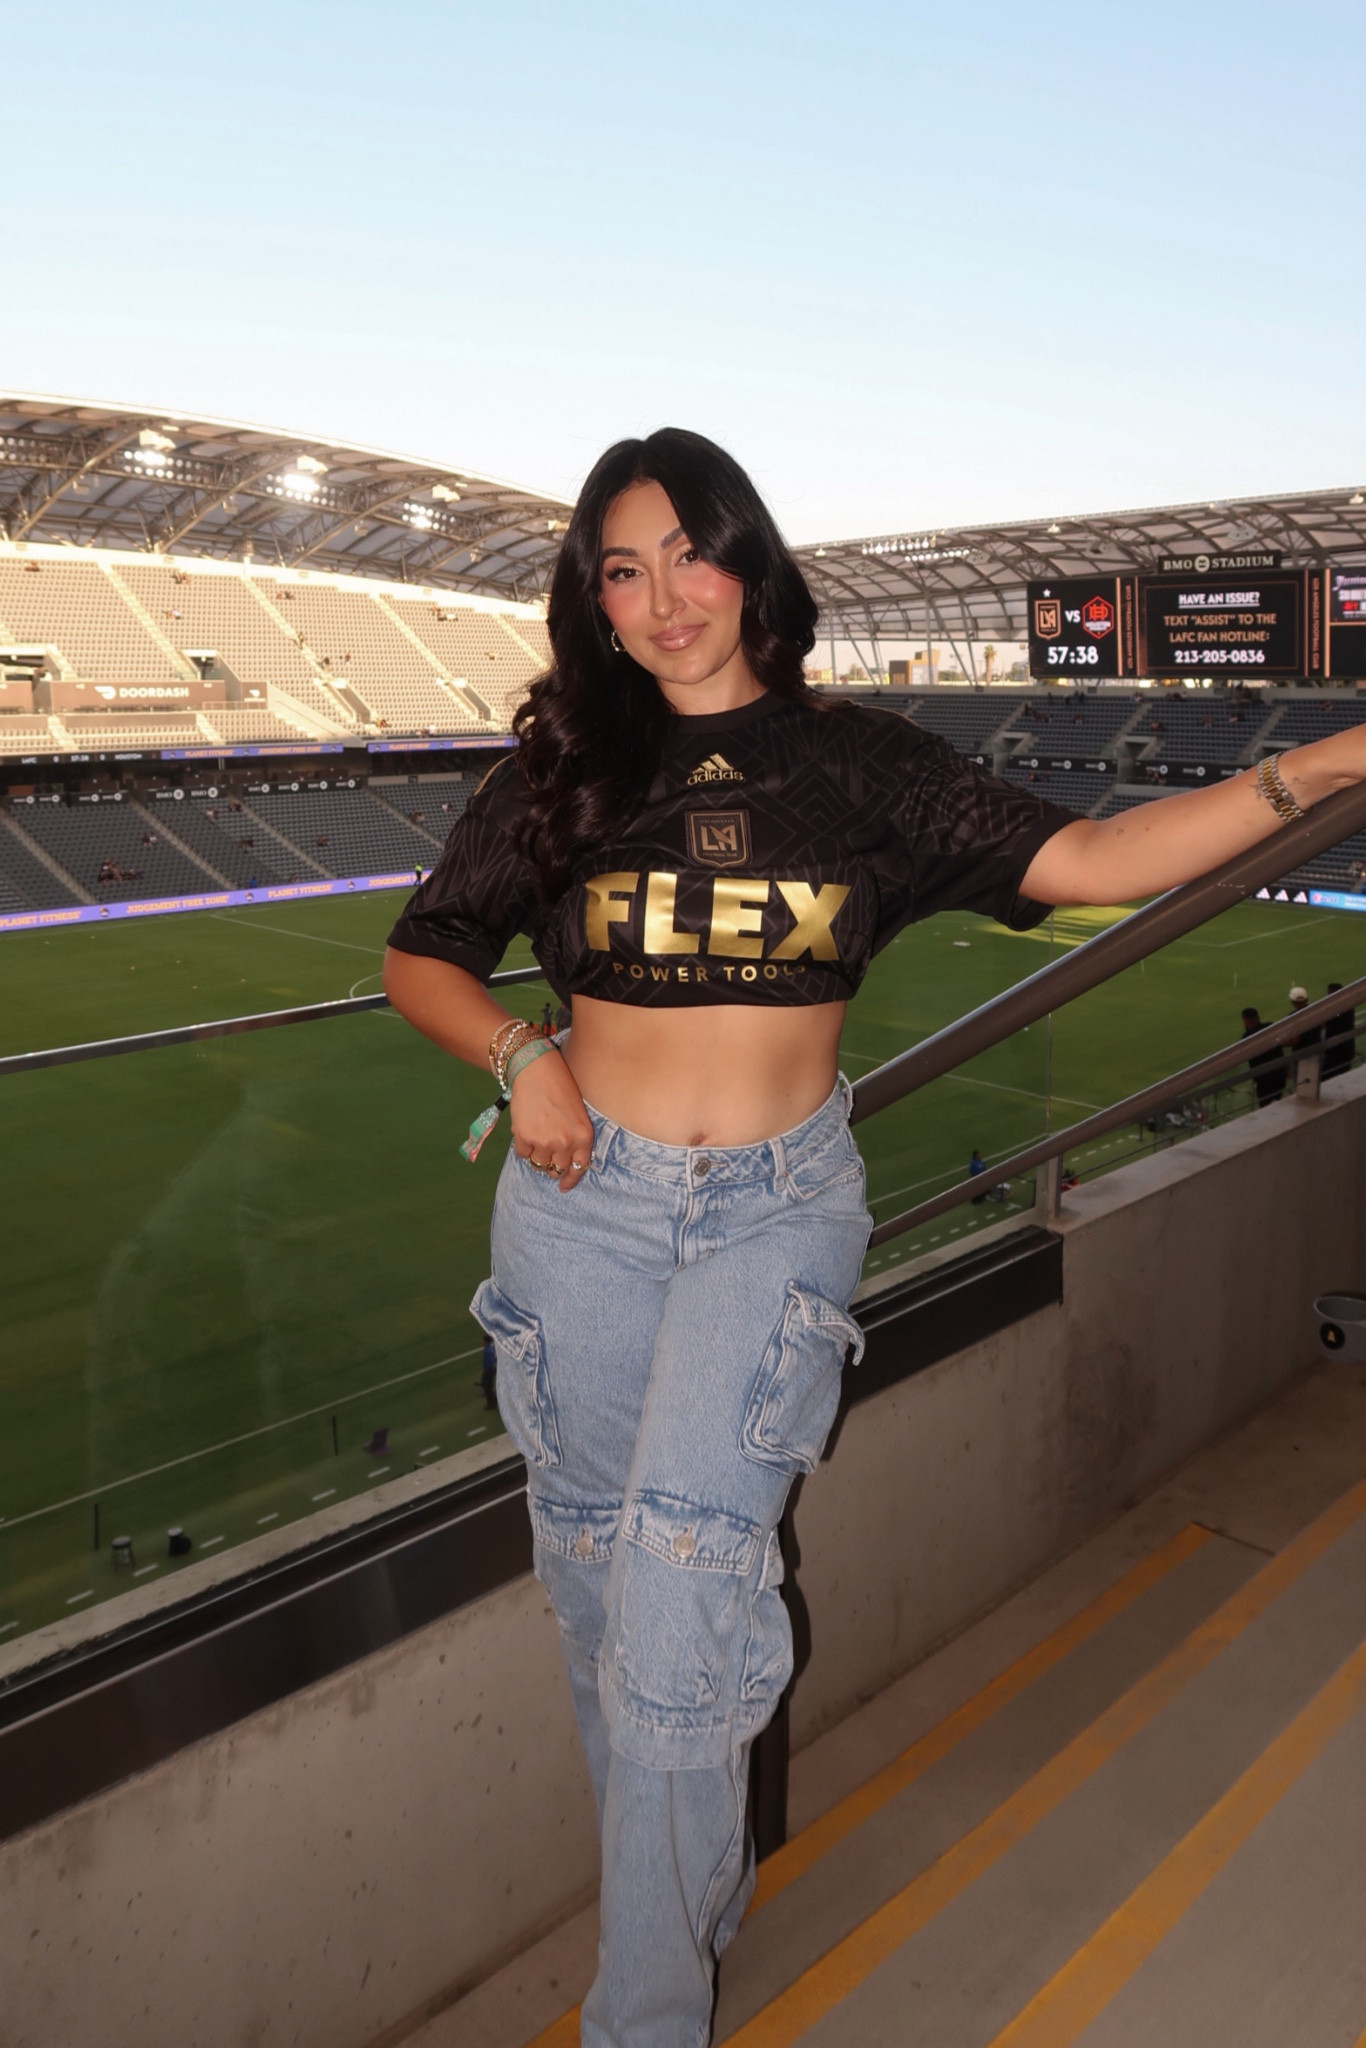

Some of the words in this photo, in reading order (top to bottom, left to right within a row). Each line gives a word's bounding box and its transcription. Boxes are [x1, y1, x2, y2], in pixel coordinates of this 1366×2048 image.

[1163, 559, 1193, 571] BMO
[1211, 555, 1275, 569] STADIUM
[1178, 593, 1206, 605] HAVE
[1207, 592, 1224, 604] AN
[1225, 591, 1260, 604] ISSUE?
[1064, 609, 1081, 623] VS
[1163, 615, 1189, 626] TEXT
[1238, 613, 1254, 625] TO
[1256, 612, 1277, 624] THE
[1169, 631, 1195, 643] LAFC
[1197, 631, 1218, 643] FAN
[1220, 630, 1270, 642] HOTLINE:
[1047, 645, 1099, 665] 57:38
[1174, 649, 1266, 664] 213-205-0836
[119, 687, 189, 698] DOORDASH
[687, 769, 744, 786] adidas
[585, 870, 851, 961] FLEX
[612, 961, 709, 982] POWER
